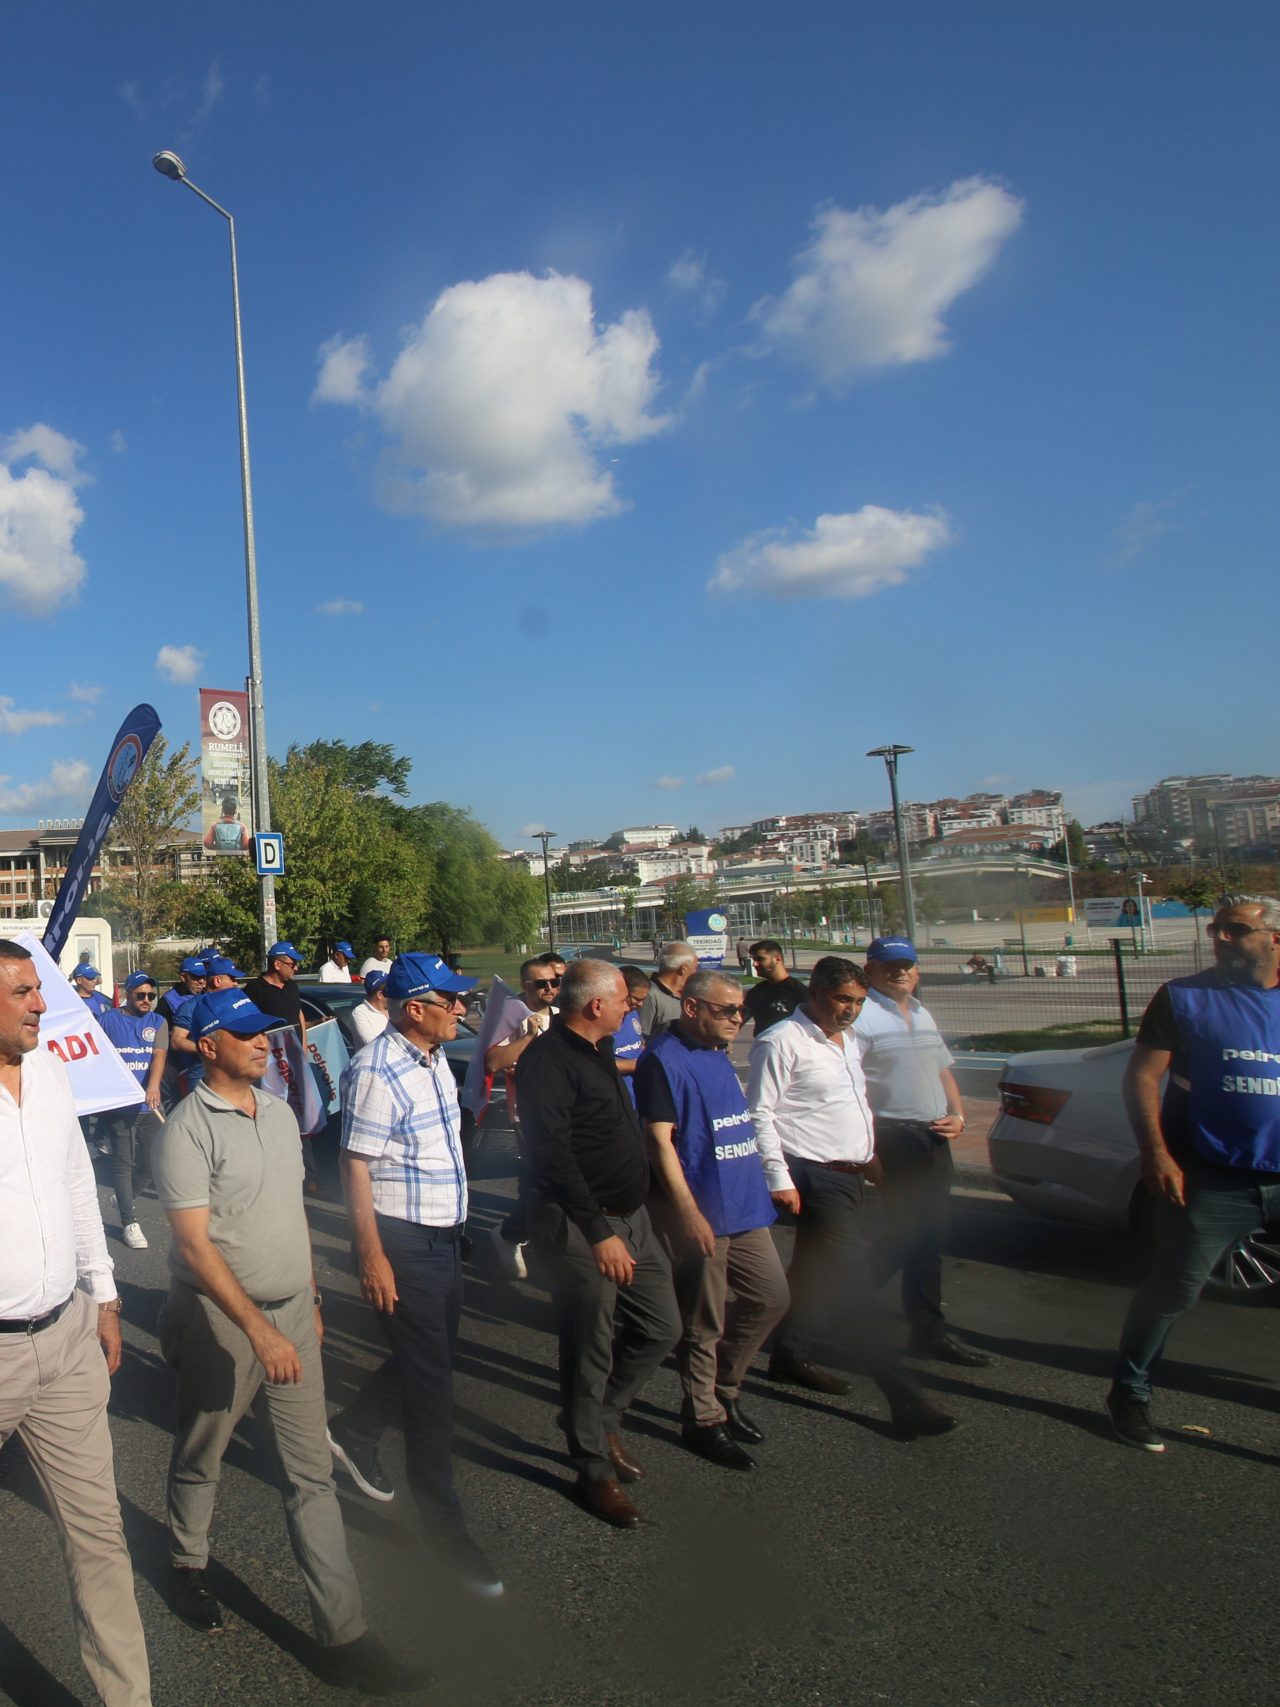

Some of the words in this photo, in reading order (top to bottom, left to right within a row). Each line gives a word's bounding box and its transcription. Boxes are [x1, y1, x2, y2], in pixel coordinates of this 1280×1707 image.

[208, 742, 243, 752] RUMELİ
[263, 842, 276, 864] D
[615, 1040, 642, 1055] petrol-
[713, 1109, 751, 1131] petrol
